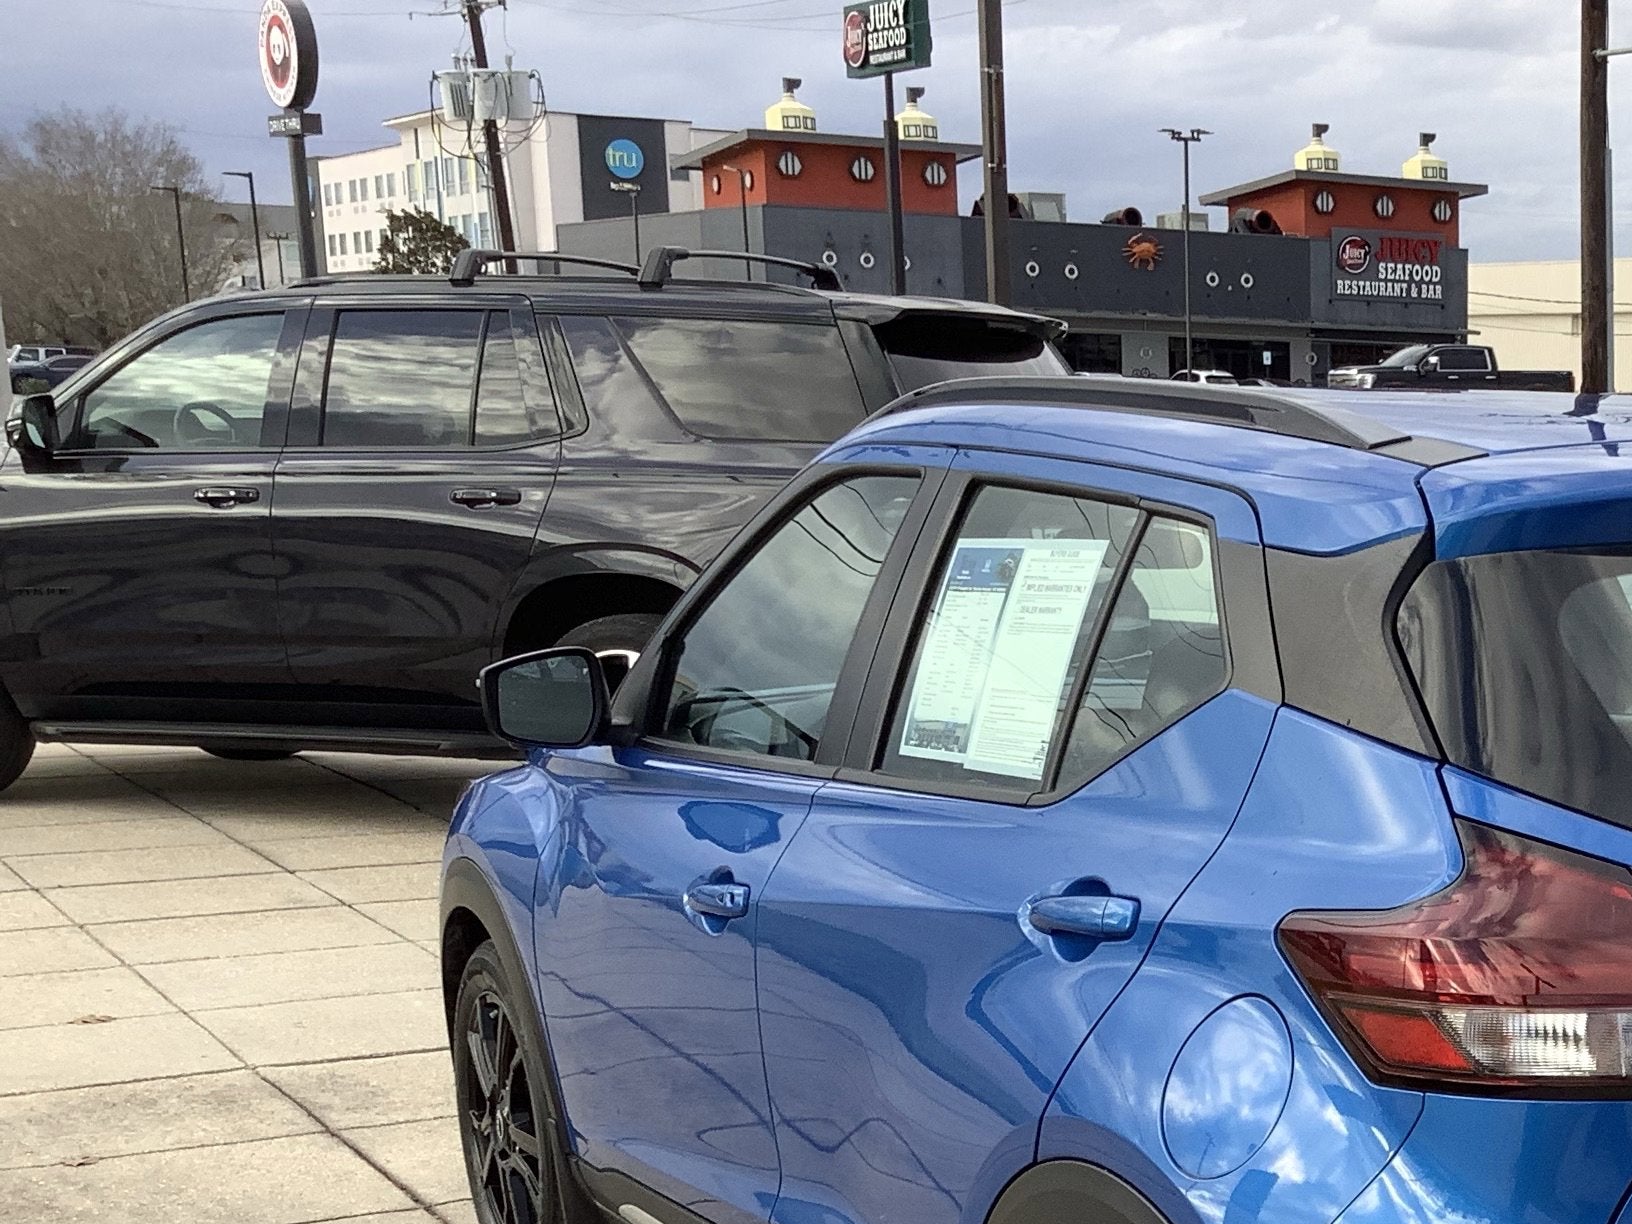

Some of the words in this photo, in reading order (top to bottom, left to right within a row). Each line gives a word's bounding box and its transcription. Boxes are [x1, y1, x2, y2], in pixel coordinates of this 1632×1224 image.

[867, 0, 904, 32] JUICY
[868, 27, 907, 51] SEAFOOD
[608, 145, 637, 168] tru
[1376, 237, 1441, 264] JUICY
[1378, 262, 1441, 282] SEAFOOD
[1337, 279, 1408, 297] RESTAURANT
[1410, 283, 1419, 298] &
[1421, 284, 1442, 299] BAR
